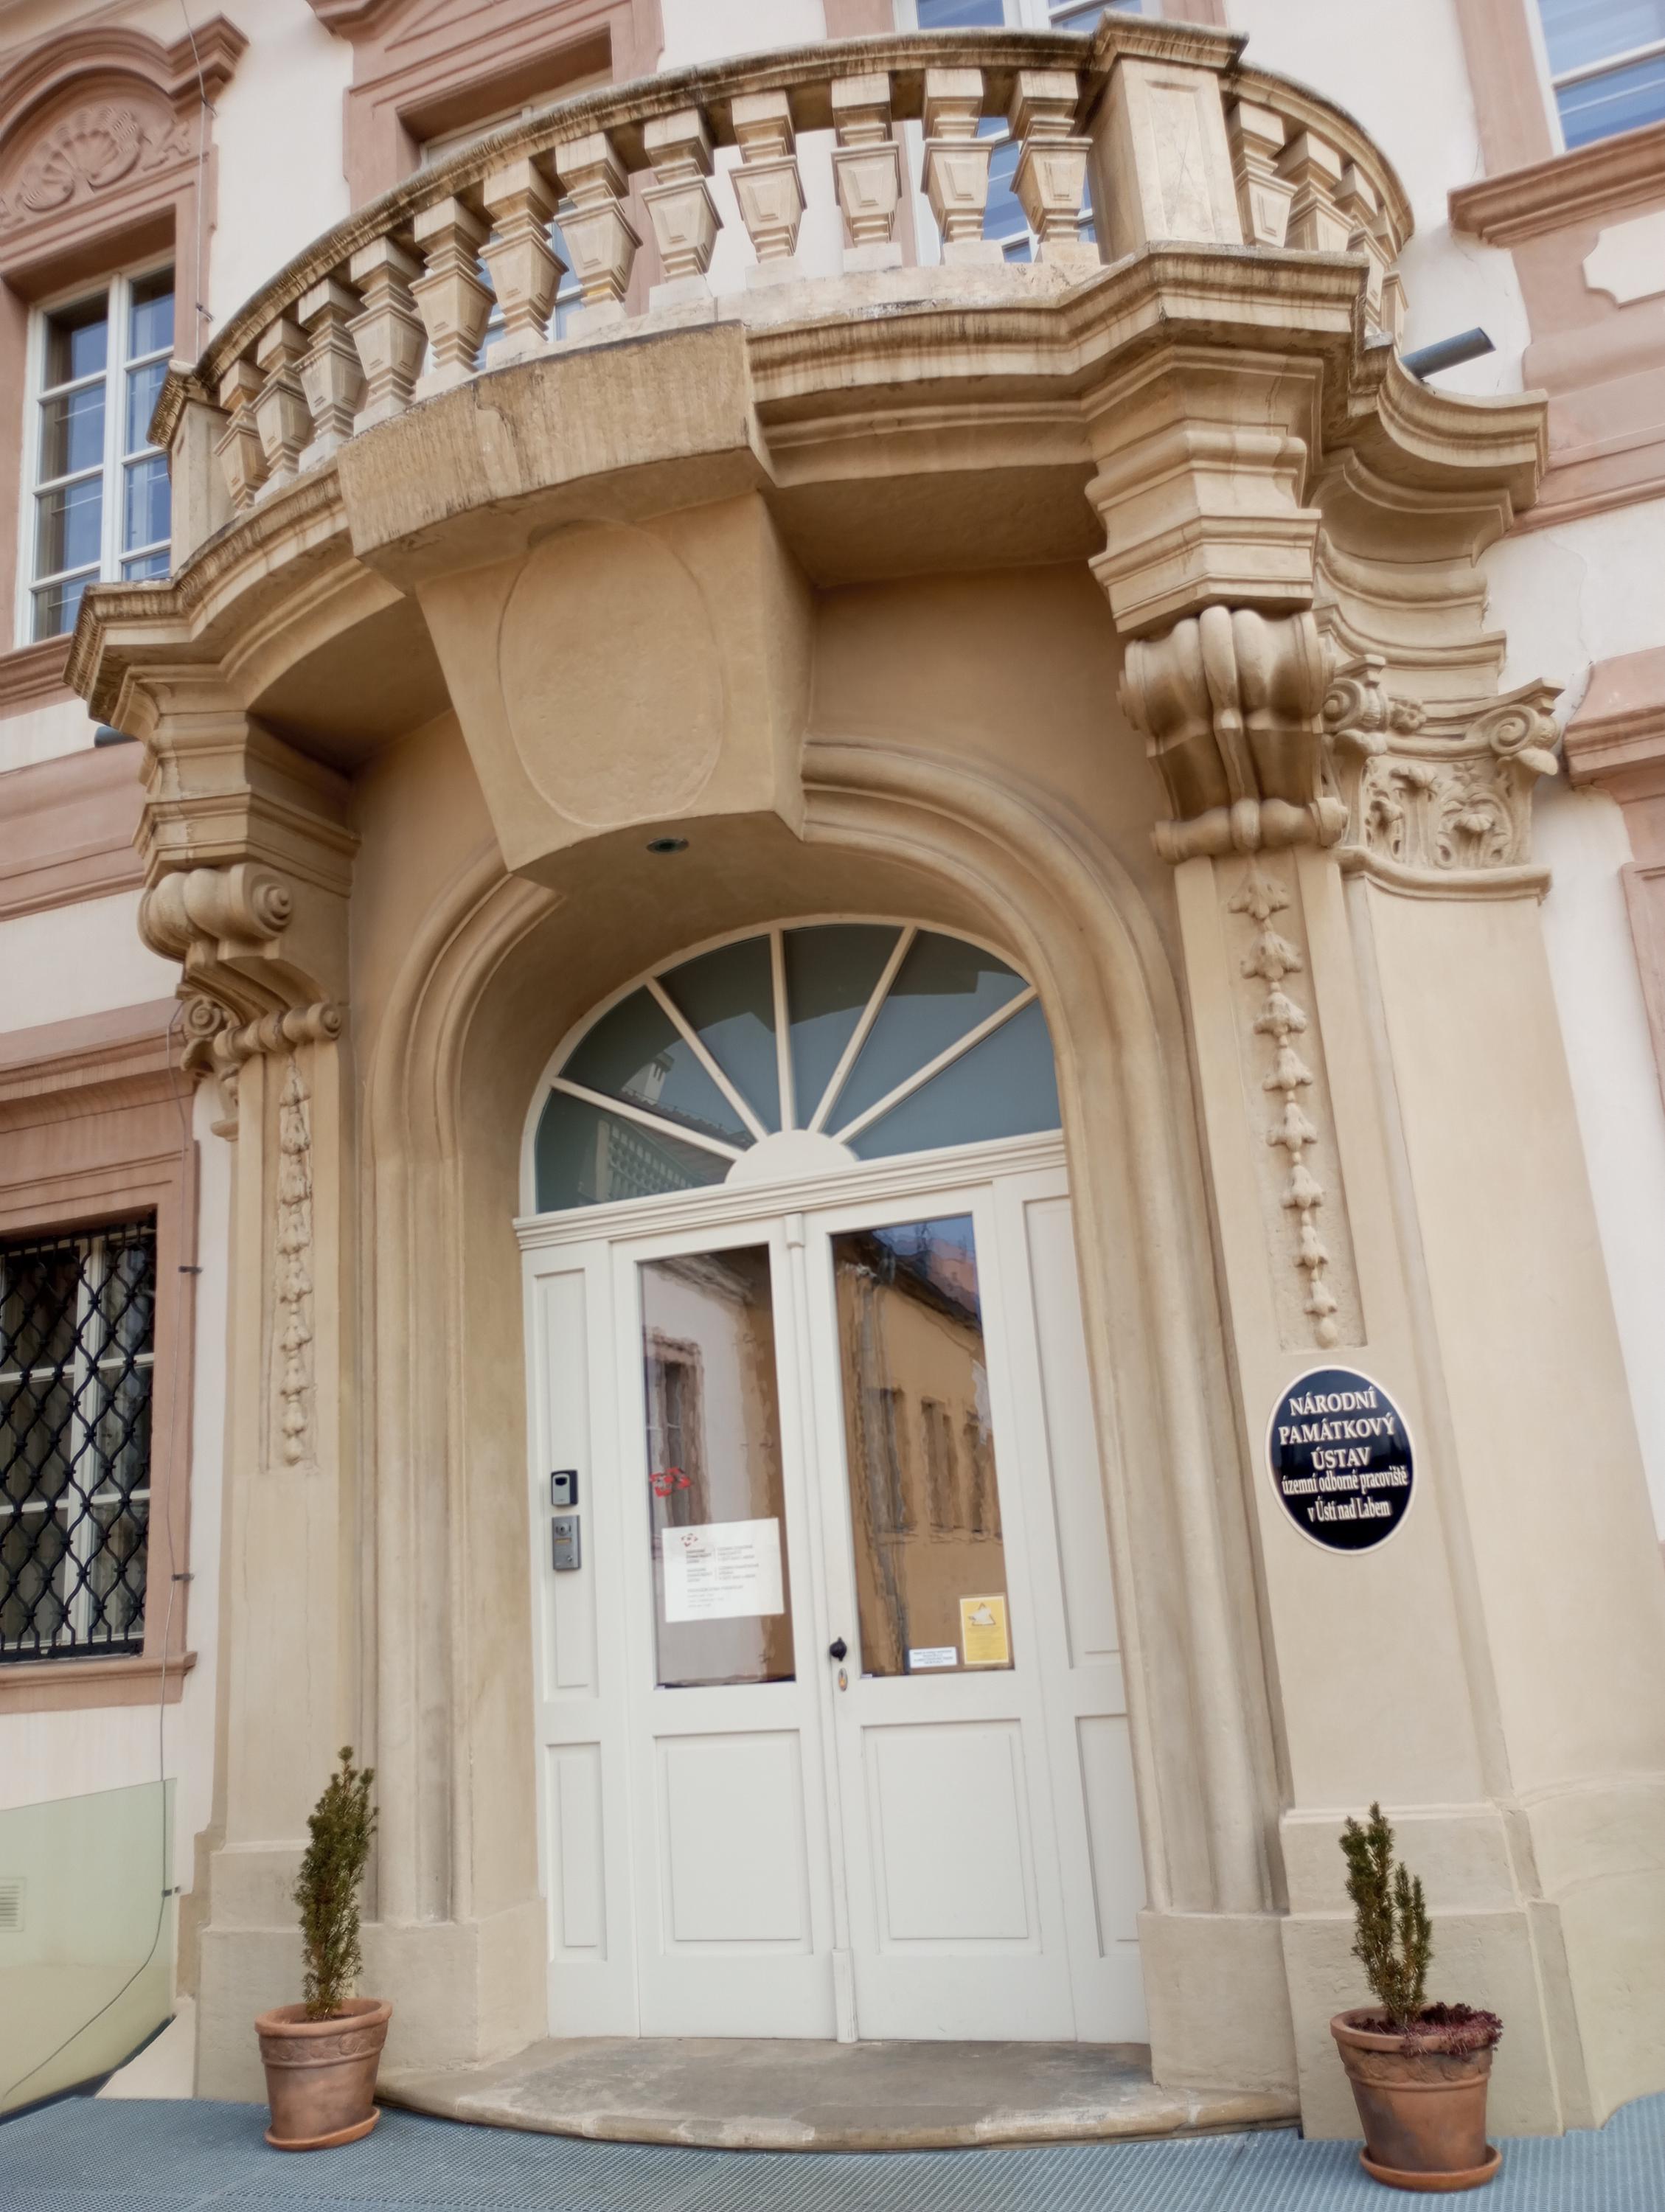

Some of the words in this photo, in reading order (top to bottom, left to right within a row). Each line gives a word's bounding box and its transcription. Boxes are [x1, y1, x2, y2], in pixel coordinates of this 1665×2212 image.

[1289, 1385, 1377, 1416] NÁRODNÍ
[1279, 1412, 1395, 1445] PAMÁTKOVÝ
[1311, 1447, 1371, 1470] ÚSTAV
[1282, 1473, 1318, 1495] územní
[1318, 1470, 1359, 1492] odborné
[1360, 1466, 1408, 1495] pracoviště
[1307, 1506, 1315, 1523] v
[1315, 1495, 1337, 1522] Ústí
[1337, 1498, 1358, 1520] nad
[1358, 1497, 1391, 1519] Labem
